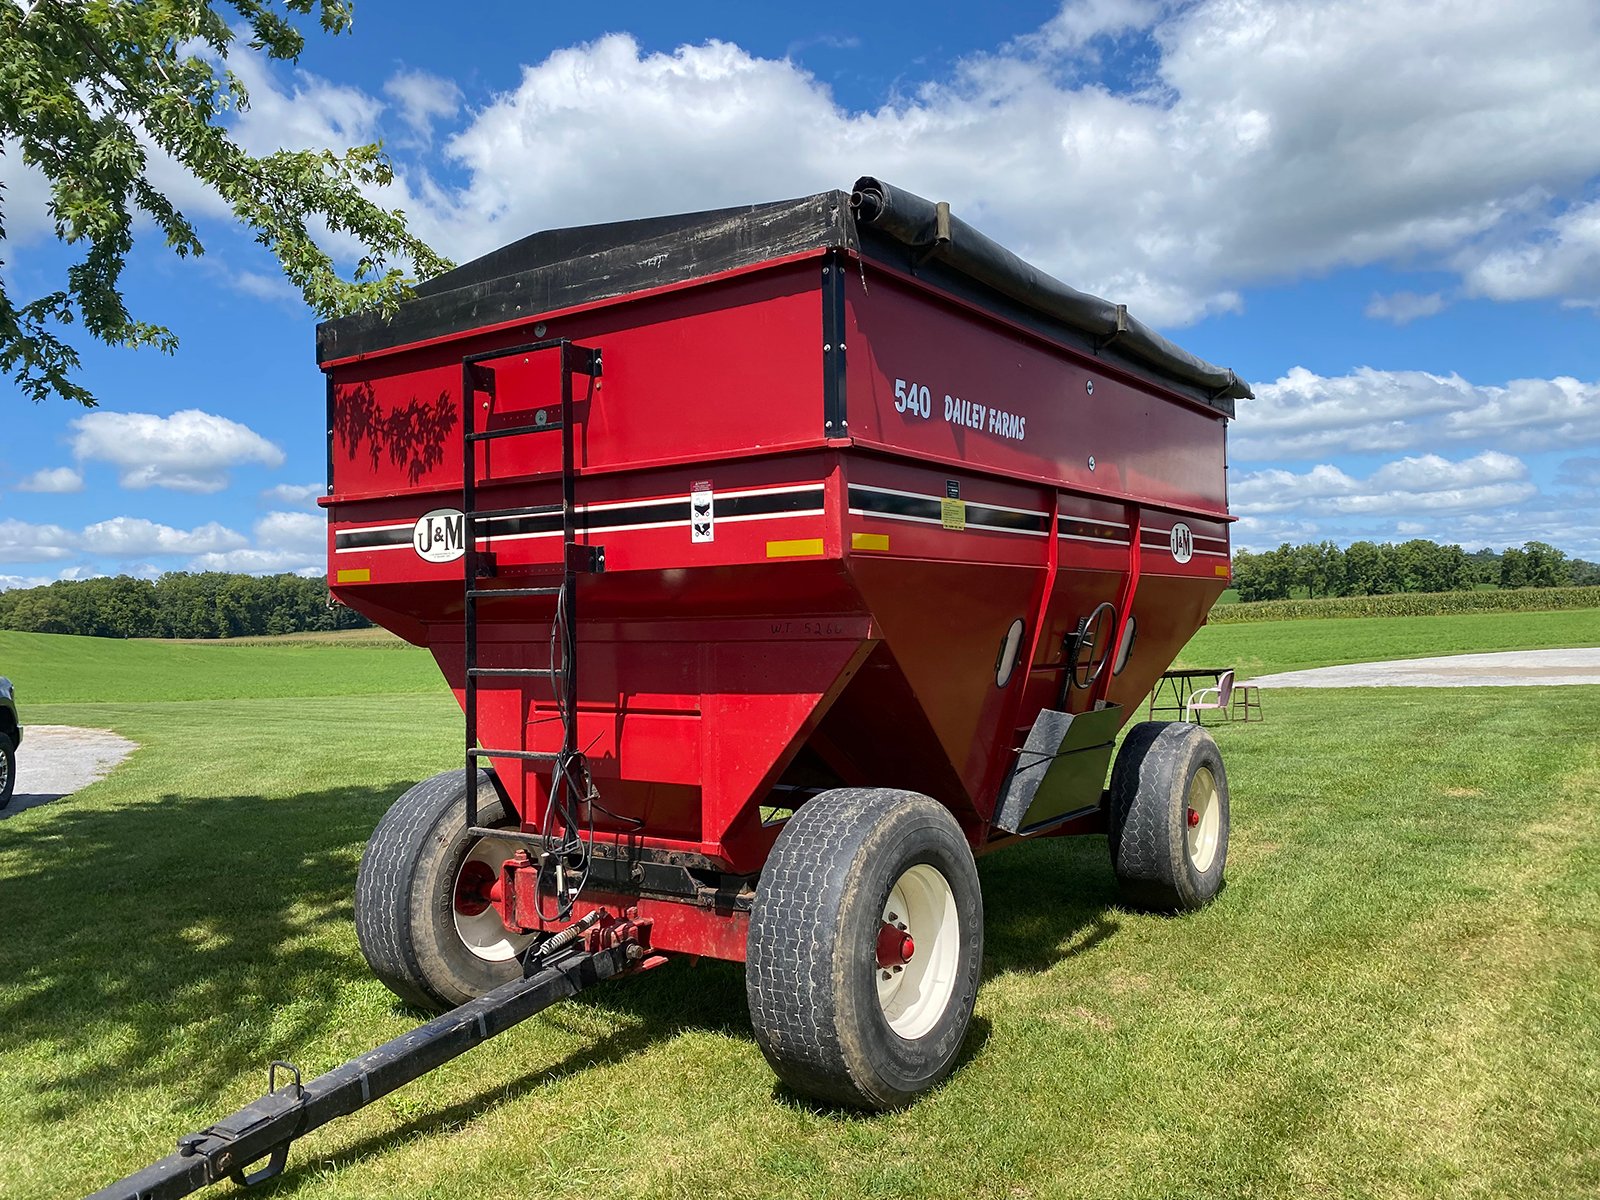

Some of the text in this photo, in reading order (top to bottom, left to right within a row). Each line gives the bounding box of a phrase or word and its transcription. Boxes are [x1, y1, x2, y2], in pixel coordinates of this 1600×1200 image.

[894, 378, 931, 419] 540
[944, 394, 1026, 440] DAILEY FARMS
[418, 514, 464, 553] J&M
[1172, 528, 1191, 556] J&M
